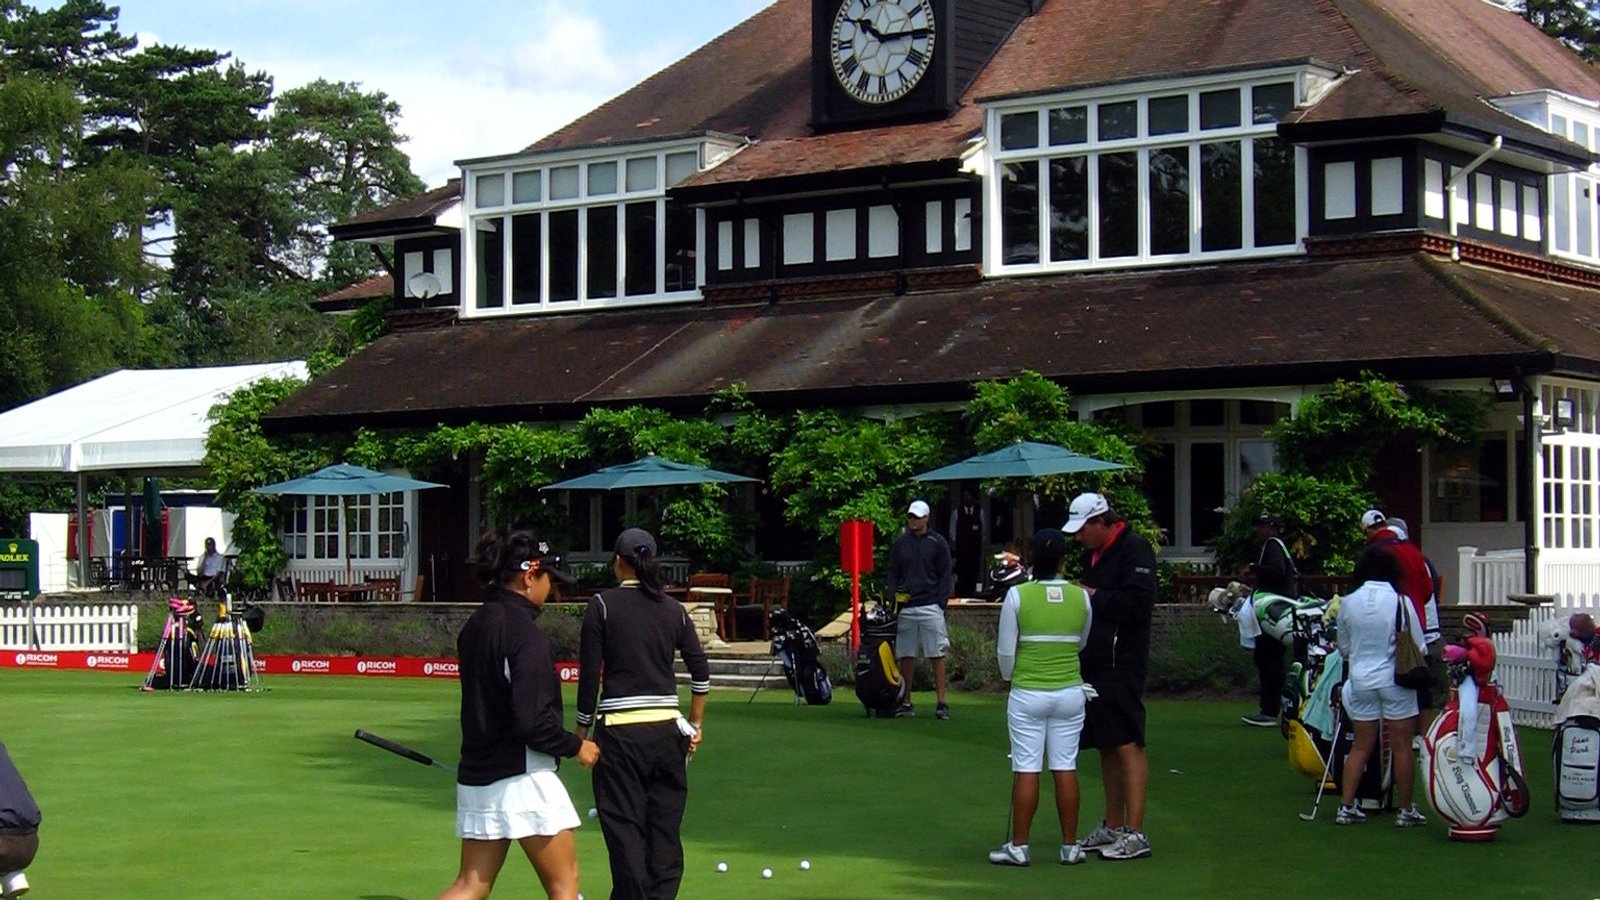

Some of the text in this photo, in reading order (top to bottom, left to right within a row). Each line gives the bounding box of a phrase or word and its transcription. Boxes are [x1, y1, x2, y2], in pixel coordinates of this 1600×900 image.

[26, 653, 58, 662] RICOH
[97, 655, 129, 664] RICOH
[301, 660, 330, 668] RICOH
[366, 661, 396, 669] RICOH
